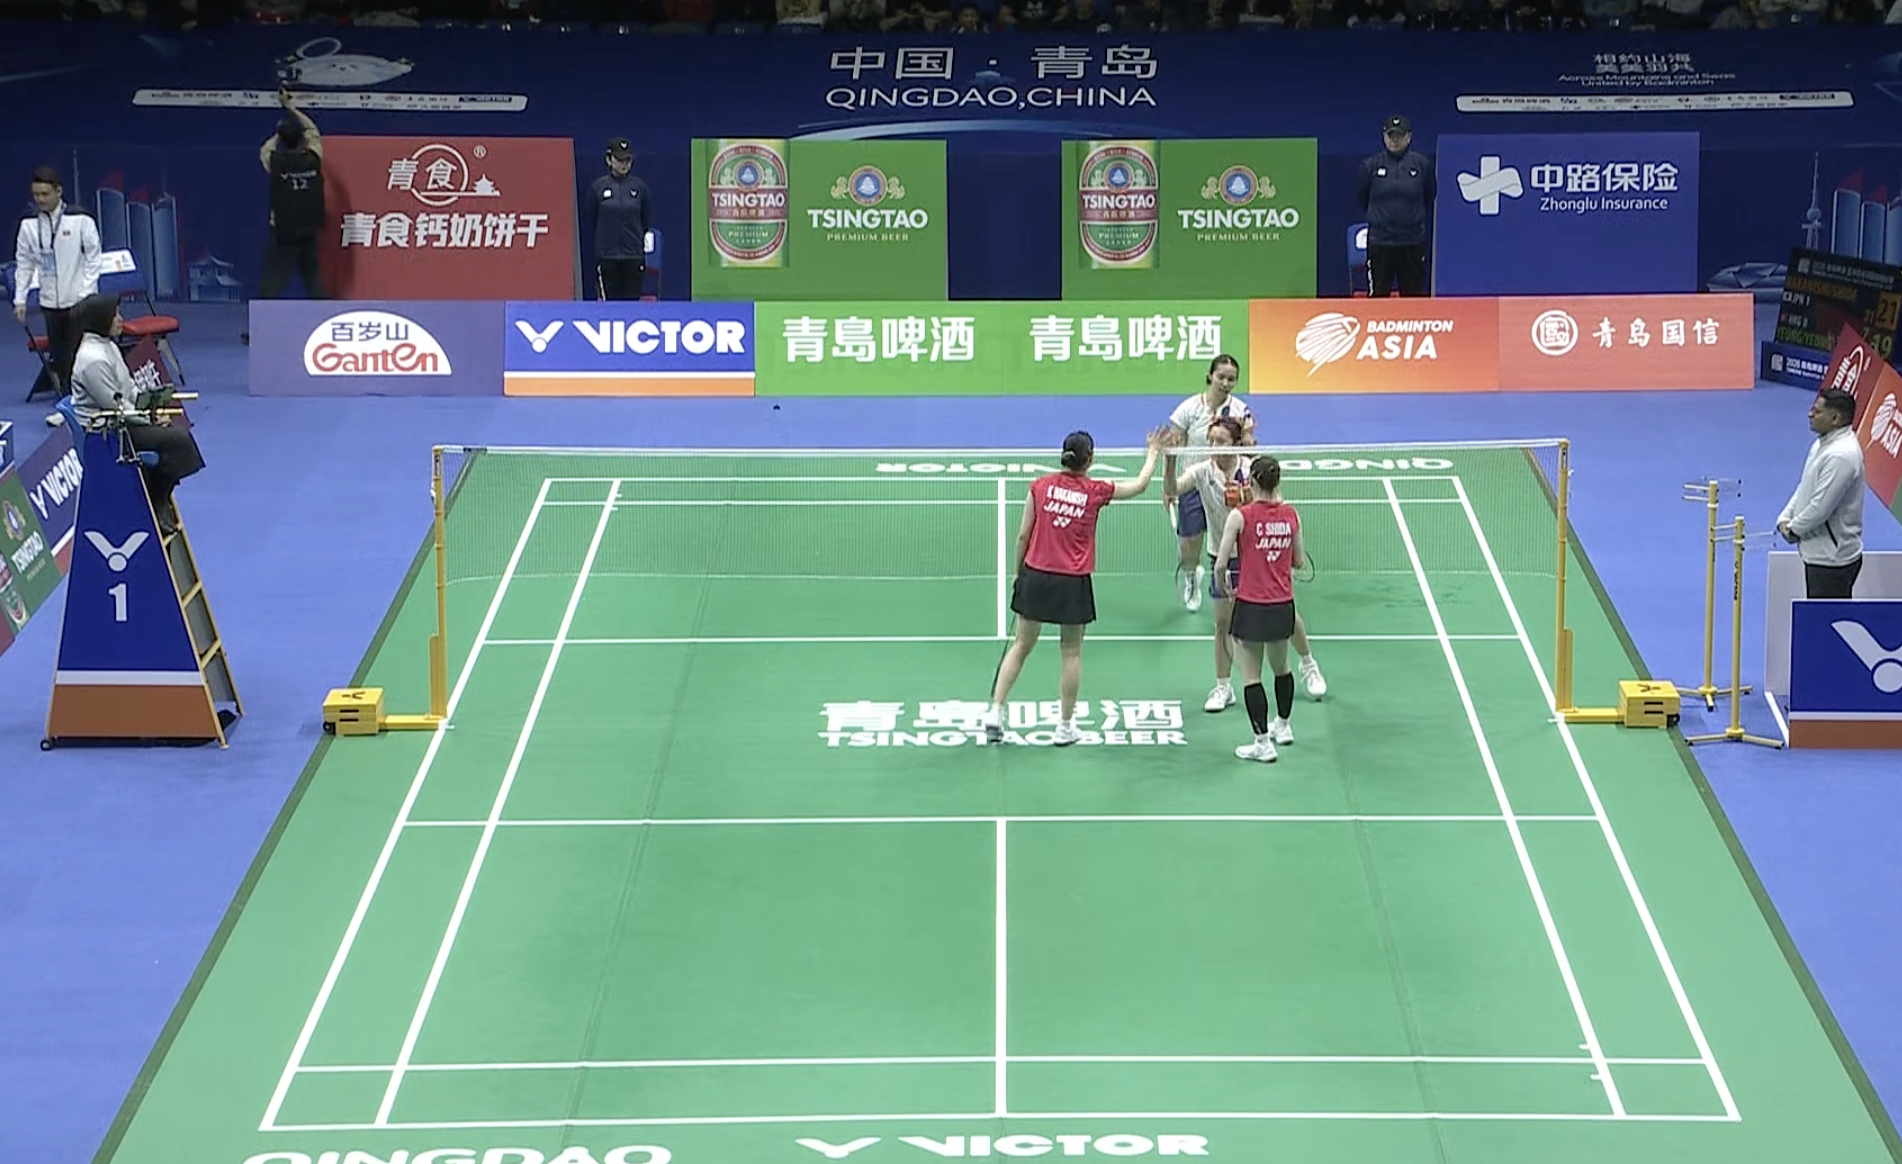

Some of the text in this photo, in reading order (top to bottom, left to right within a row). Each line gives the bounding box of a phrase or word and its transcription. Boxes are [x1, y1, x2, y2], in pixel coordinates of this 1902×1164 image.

[826, 86, 1157, 110] QINGDAO,CHINA
[387, 157, 458, 191] 青食
[1531, 163, 1678, 192] 中路保险
[712, 192, 785, 207] TSINGTAO
[1083, 194, 1156, 209] TSINGTAO
[1540, 197, 1668, 214] Zhonglu Insurance
[807, 208, 928, 229] TSINGTAO
[1177, 208, 1299, 229] TSINGTAO
[341, 212, 548, 248] 青食钙奶饼干
[826, 233, 909, 241] PREMIUM BEER
[1197, 232, 1280, 241] PREMIUM BEER
[331, 321, 408, 342] 百岁山
[572, 319, 745, 354] VICTOR
[1366, 320, 1454, 334] BADMINTON
[782, 315, 974, 363] 青島啤酒
[1029, 315, 1222, 362] 青島啤酒
[1356, 335, 1437, 360] ASIA
[42, 448, 83, 506] VICTOR
[1043, 500, 1087, 518] JAPAN
[1256, 522, 1263, 536] C
[11, 530, 44, 574] TSINGTAO
[1255, 537, 1292, 549] JAPAN
[108, 582, 127, 622] 1
[898, 1134, 1209, 1157] VICTOR
